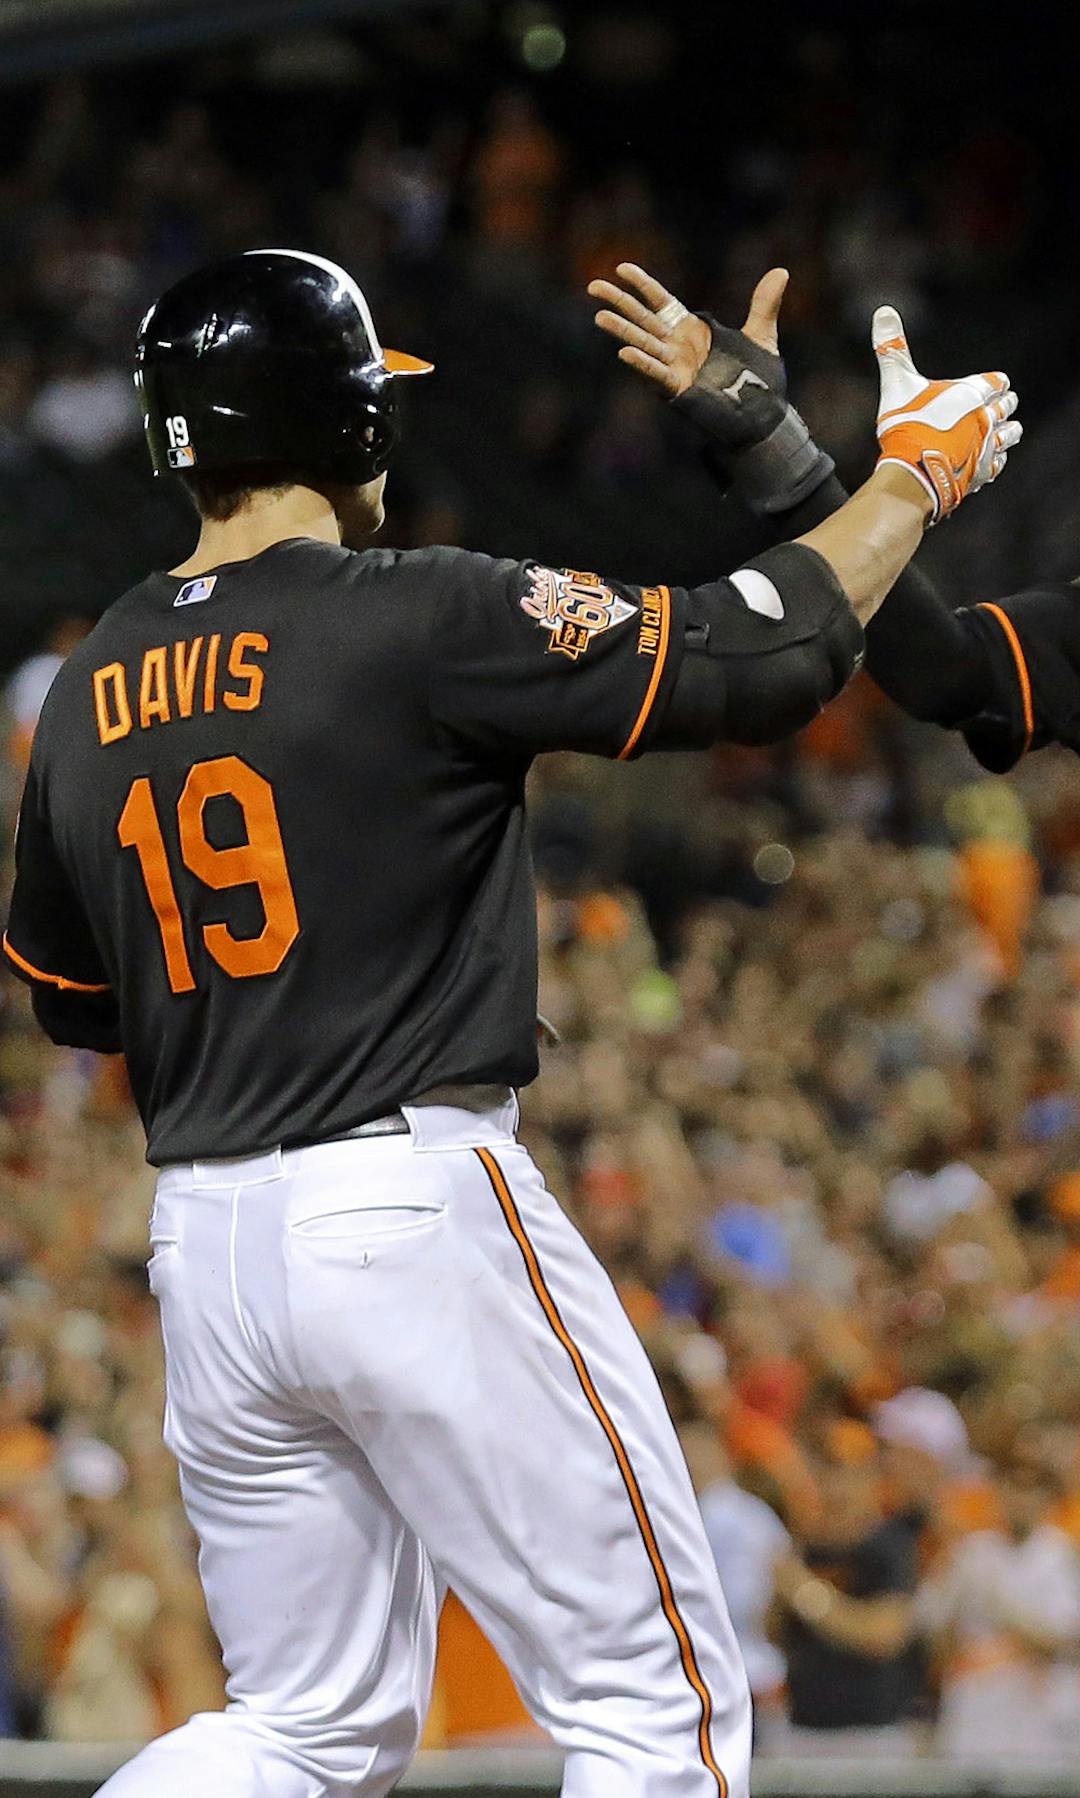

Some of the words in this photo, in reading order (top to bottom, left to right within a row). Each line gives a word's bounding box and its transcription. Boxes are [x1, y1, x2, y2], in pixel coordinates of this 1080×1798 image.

[166, 416, 189, 448] 19
[557, 582, 614, 630] 60
[637, 626, 660, 655] TOM
[93, 632, 270, 745] DAVIS
[117, 755, 300, 993] 19
